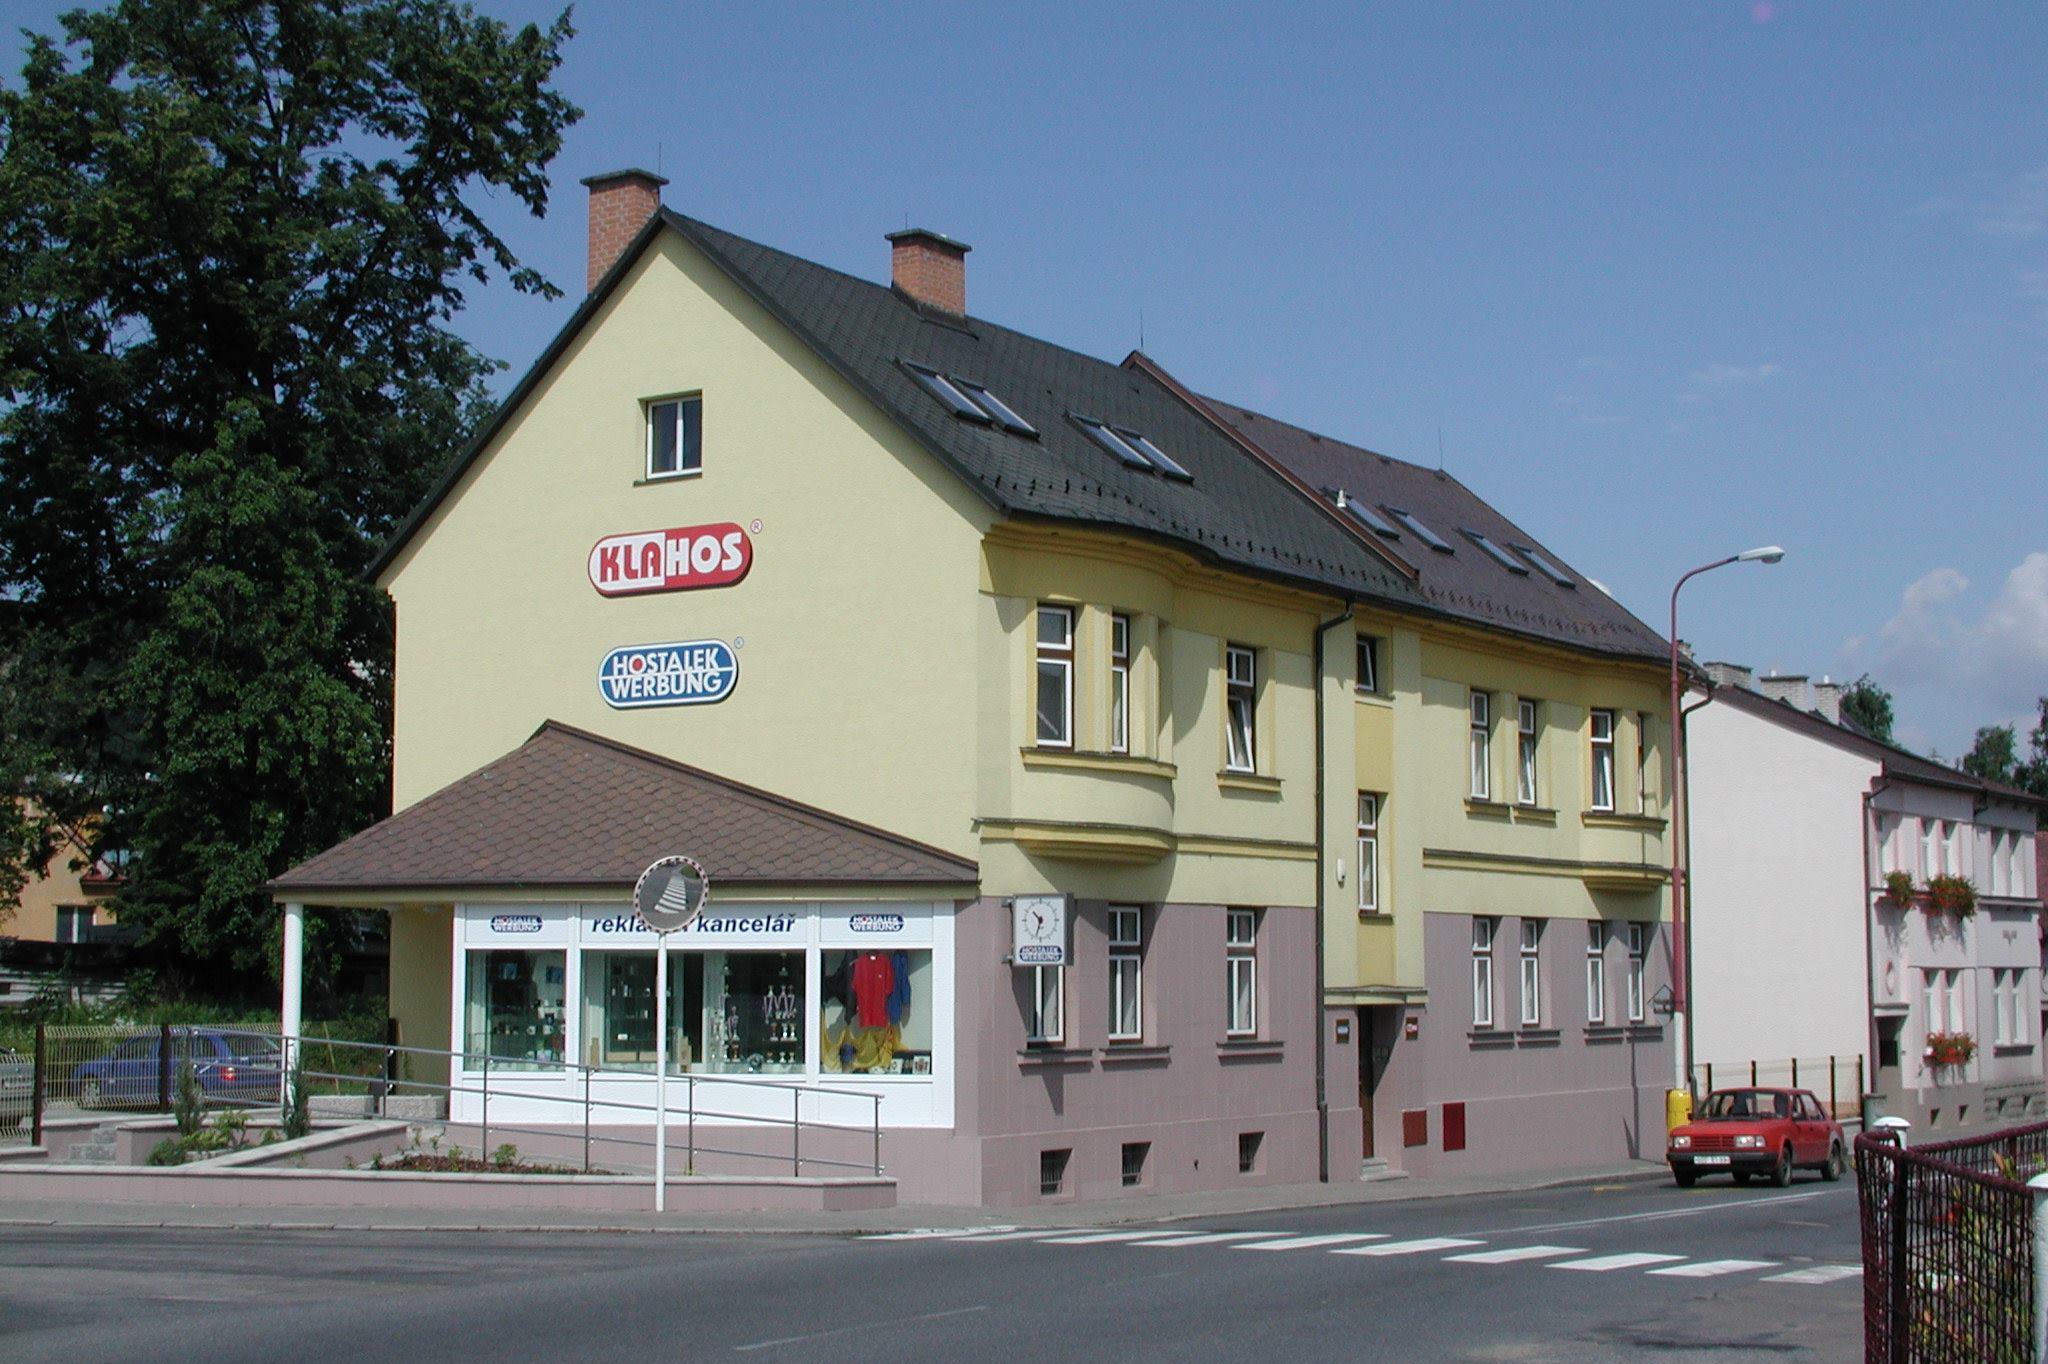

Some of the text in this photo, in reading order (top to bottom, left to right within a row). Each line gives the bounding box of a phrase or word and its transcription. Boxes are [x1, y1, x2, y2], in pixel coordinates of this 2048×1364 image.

[600, 532, 743, 582] KLAHOS
[612, 648, 719, 676] HOSTALEK
[610, 672, 722, 699] WERBUNG
[697, 912, 796, 932] kancelář
